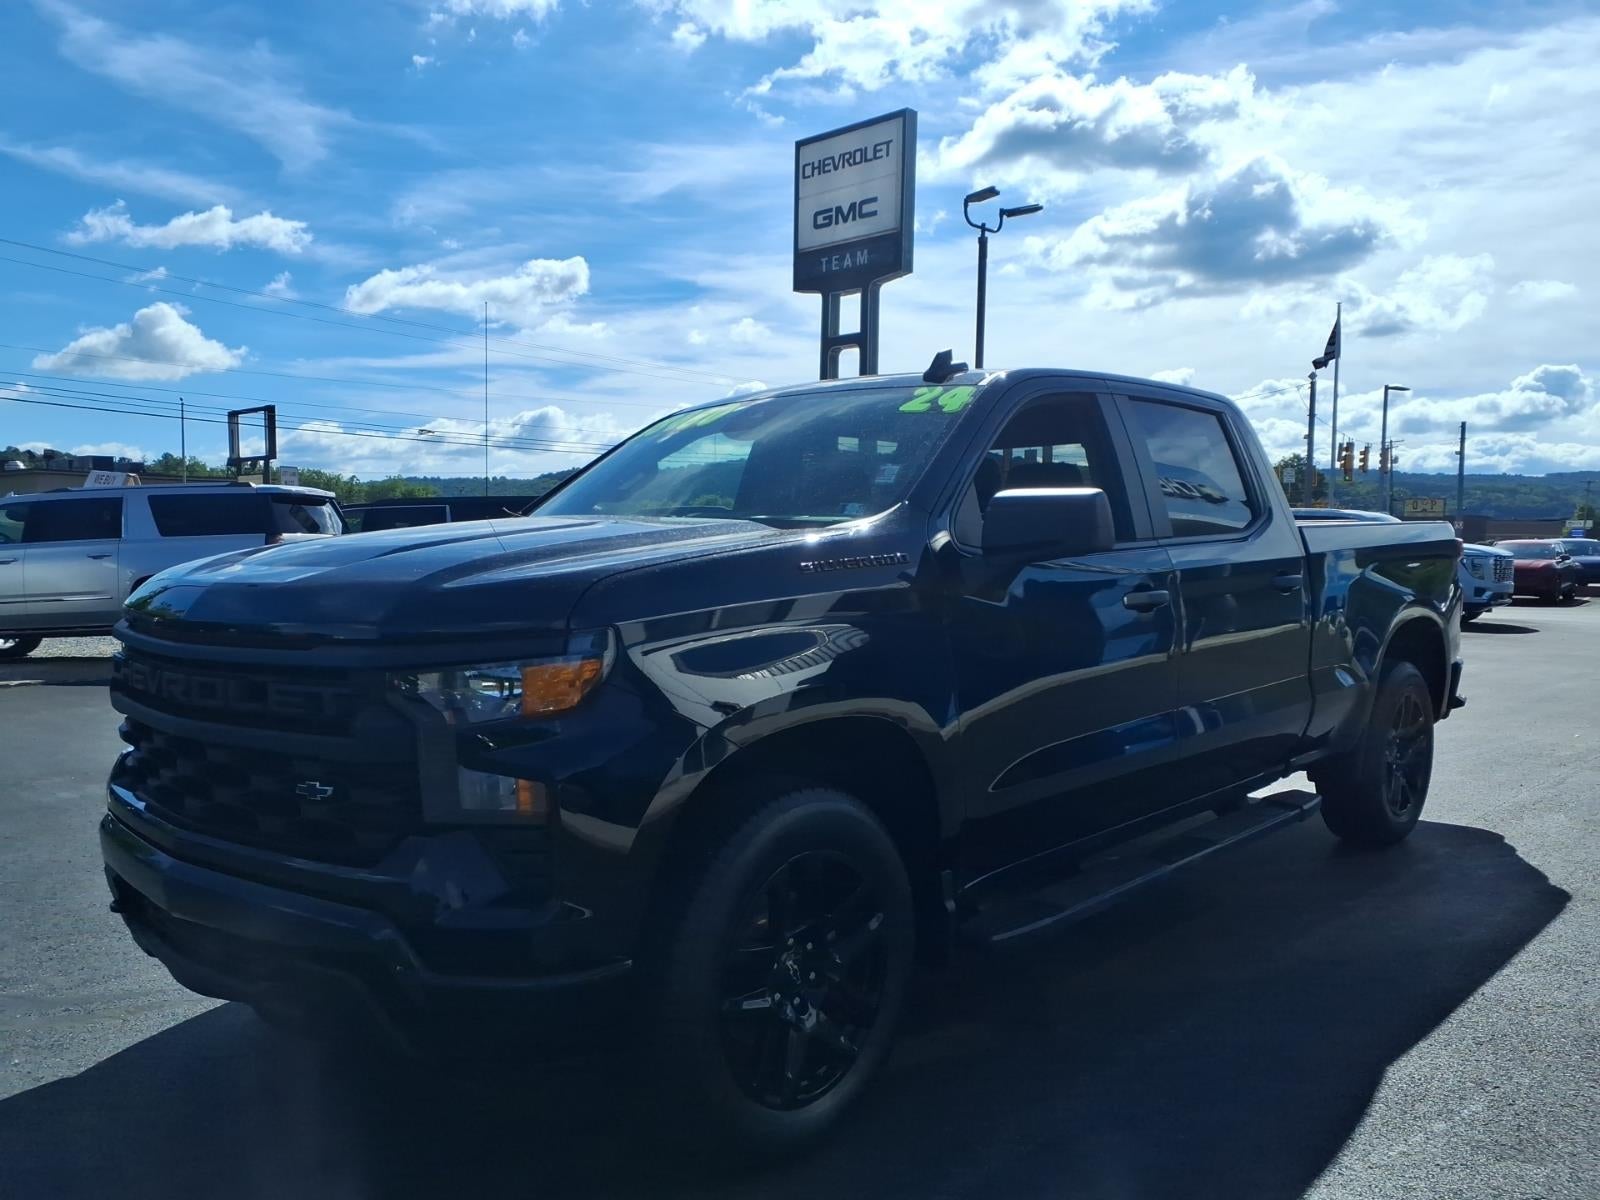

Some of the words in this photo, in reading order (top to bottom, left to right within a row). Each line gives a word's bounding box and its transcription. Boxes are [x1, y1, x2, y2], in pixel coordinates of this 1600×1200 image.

[802, 139, 893, 180] CHEVROLET
[813, 196, 878, 230] GMC
[821, 249, 868, 273] TEAM
[899, 385, 977, 414] 24
[799, 552, 909, 574] SILVERADO
